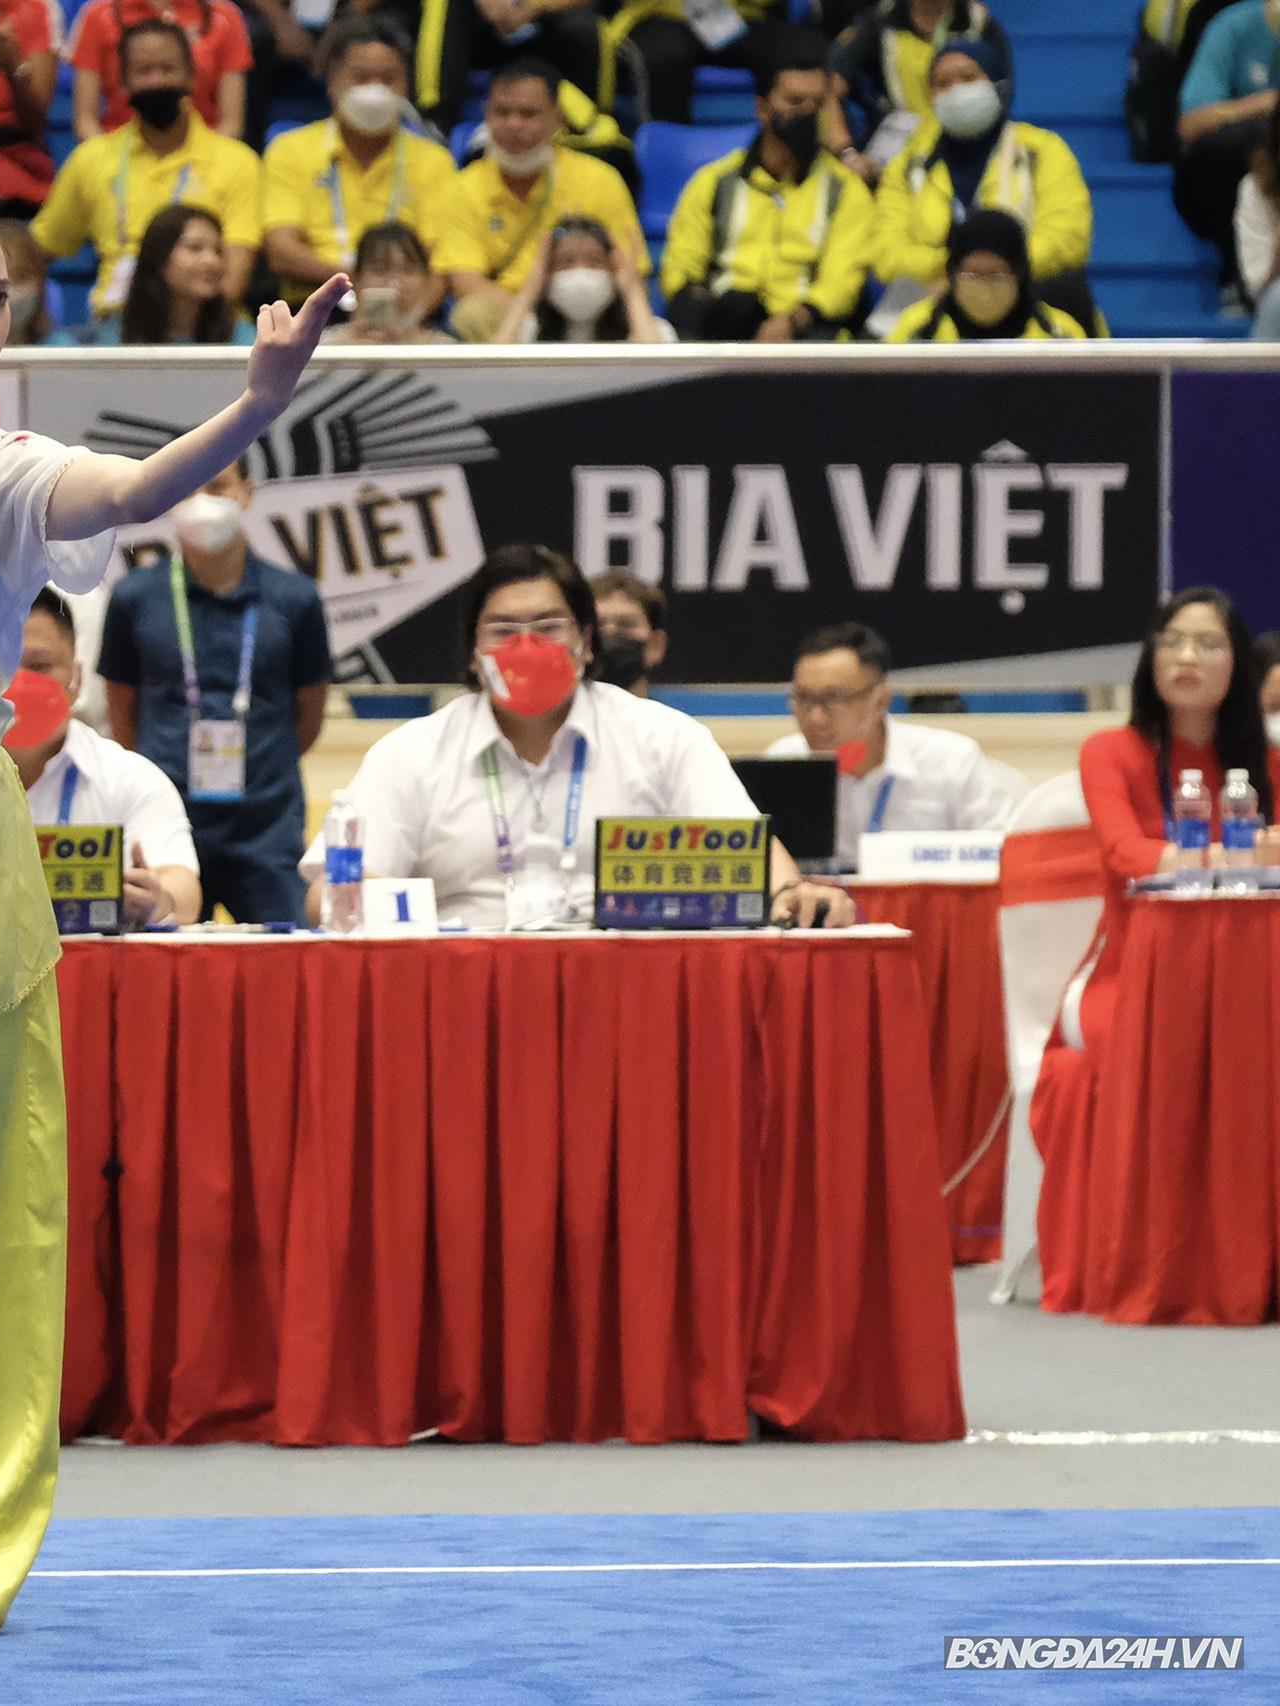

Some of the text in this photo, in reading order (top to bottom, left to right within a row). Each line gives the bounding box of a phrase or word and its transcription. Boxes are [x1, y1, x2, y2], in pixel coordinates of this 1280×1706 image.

[269, 482, 451, 581] VIỆT
[572, 438, 1129, 615] BIA VIỆT
[607, 822, 762, 852] JustTool
[392, 889, 414, 922] 1
